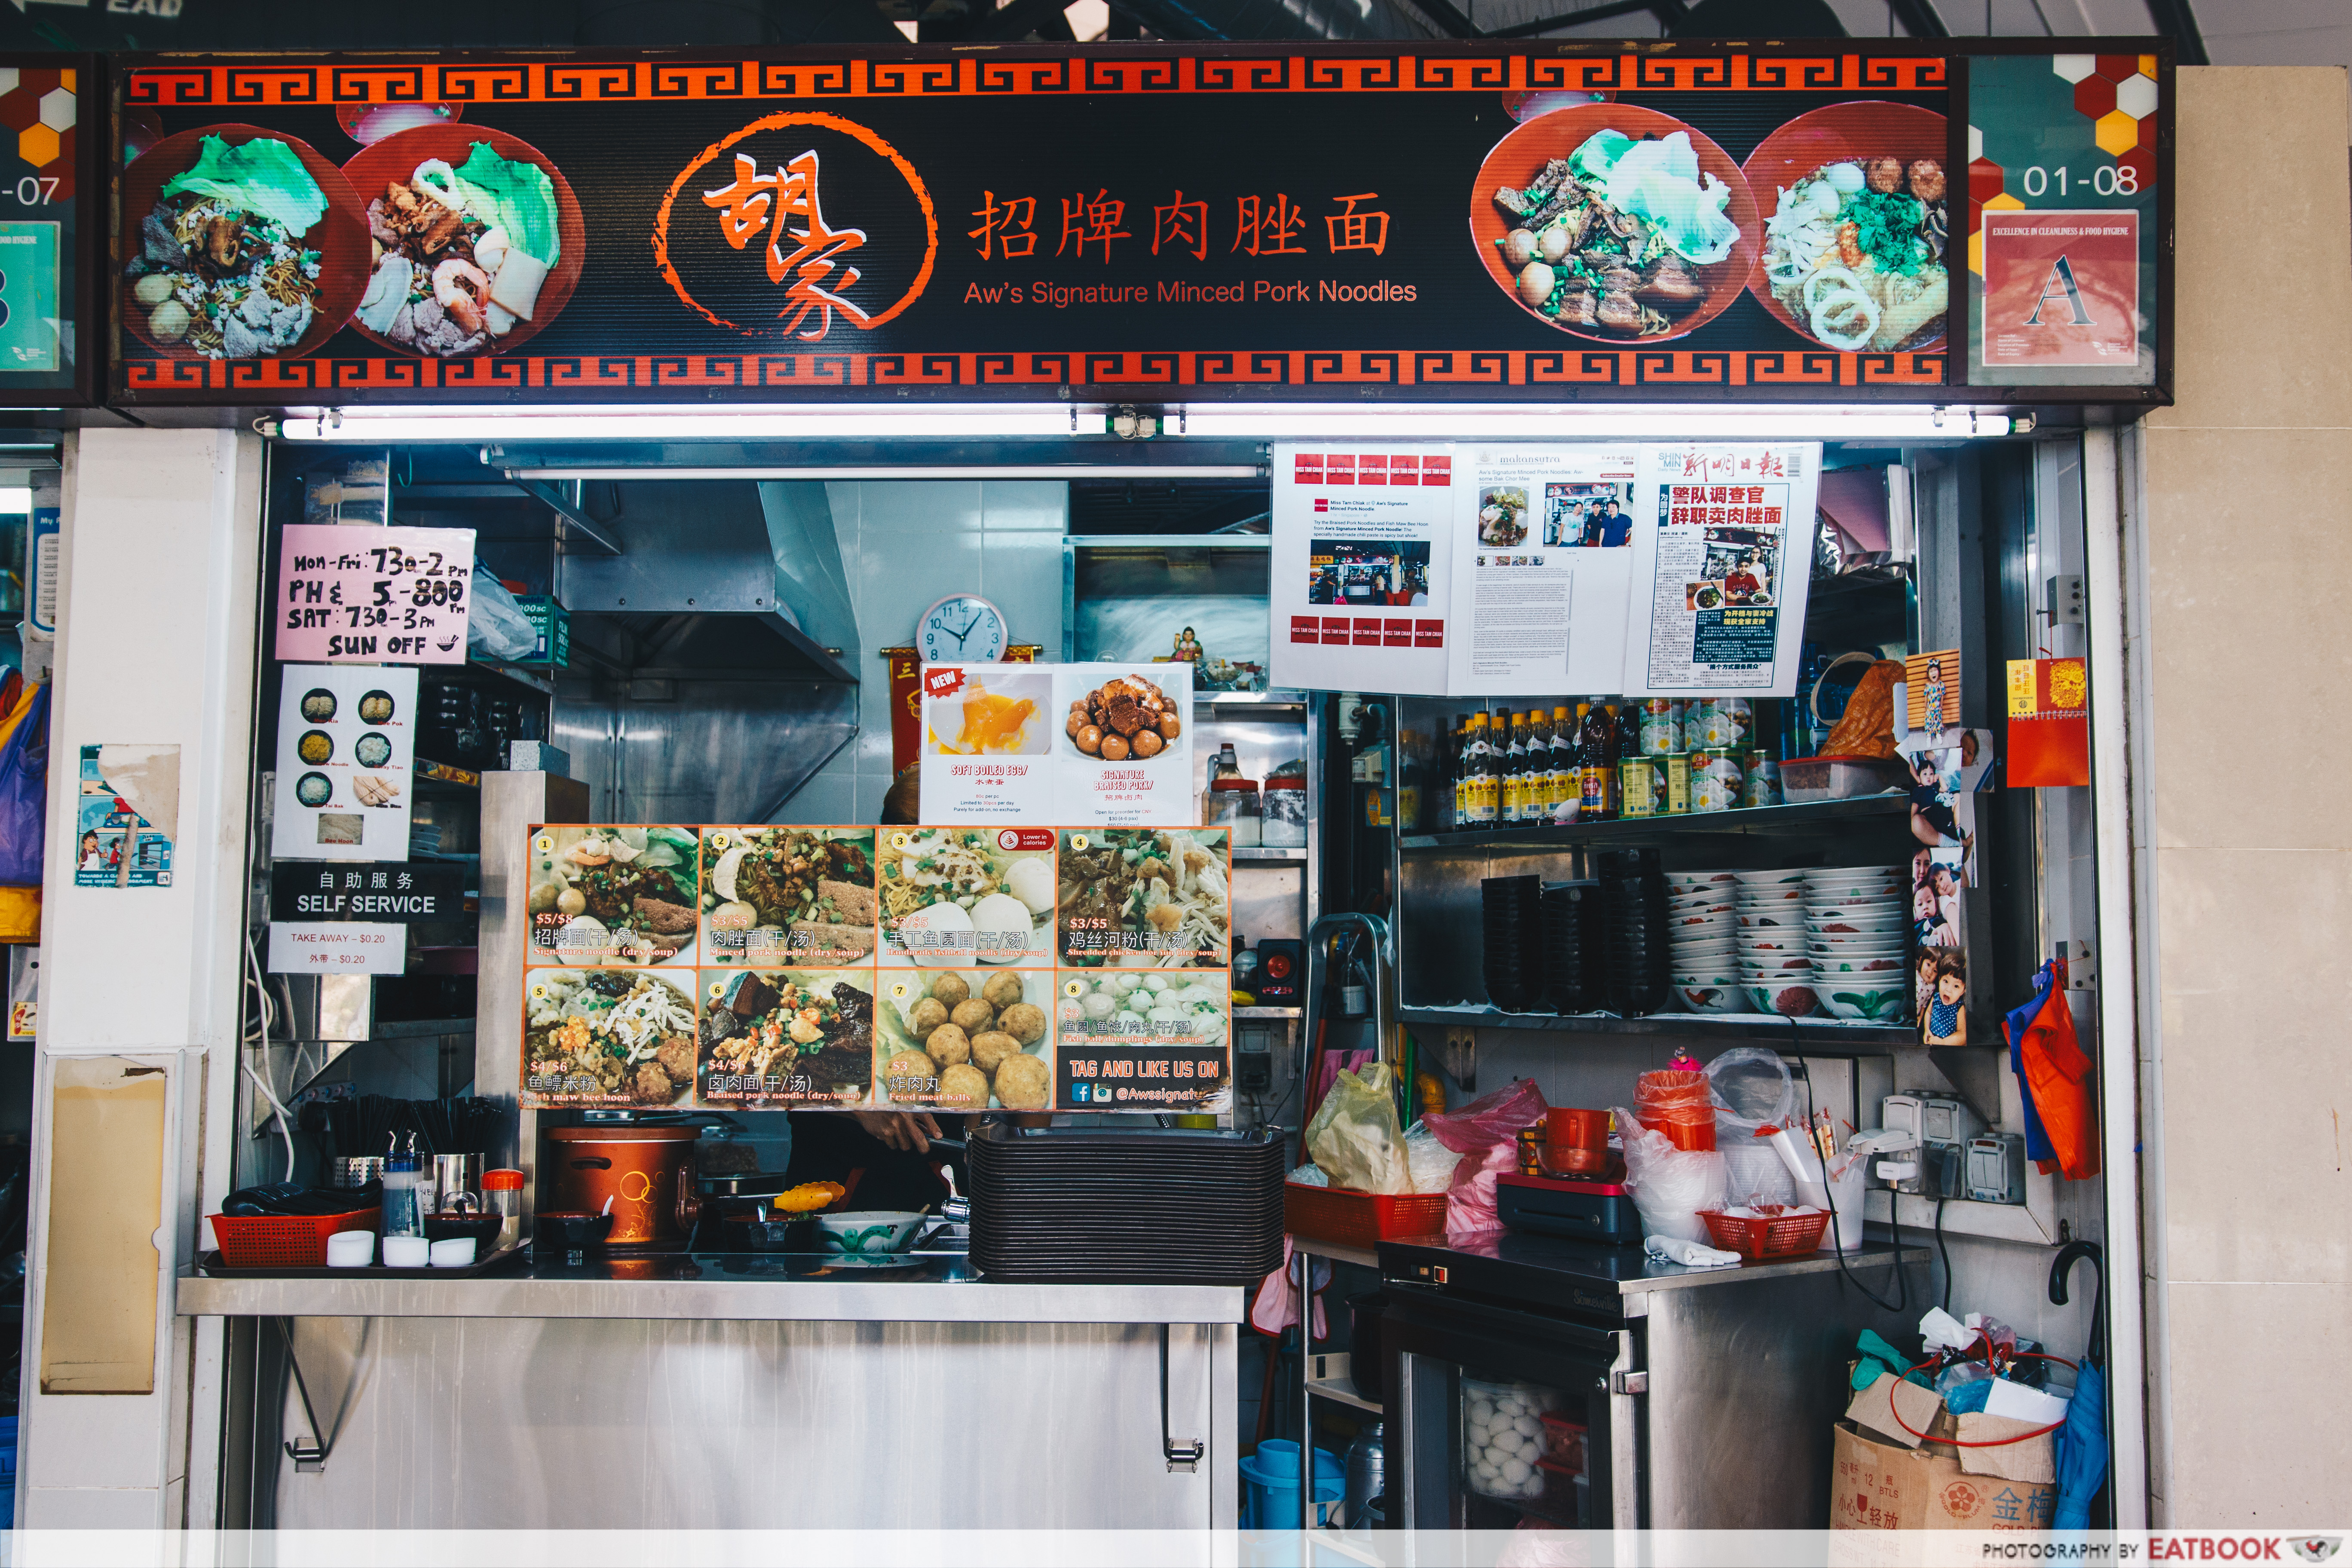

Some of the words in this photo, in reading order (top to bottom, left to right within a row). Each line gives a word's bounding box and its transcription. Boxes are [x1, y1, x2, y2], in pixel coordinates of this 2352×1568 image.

[2024, 165, 2139, 196] 01-08
[968, 188, 1390, 265] 招牌肉脞面
[1992, 227, 2030, 236] EXCELLENCE
[2030, 227, 2037, 235] IN
[2038, 227, 2078, 236] CLEANLINESS
[2079, 227, 2084, 235] &
[2103, 227, 2129, 236] HYGIENE
[964, 282, 1023, 304] Aw's
[1032, 282, 1148, 309] Signature
[1158, 281, 1244, 302] Minced
[1255, 280, 1310, 302] Pork
[1320, 279, 1417, 302] Noodles
[2023, 254, 2098, 326] A
[1500, 454, 1560, 463] makansutra
[1672, 486, 1764, 504] 警队调查官
[1660, 493, 1668, 517] 为圆梦
[1671, 506, 1782, 525] 辞职卖肉脞面
[289, 579, 323, 603] PH
[330, 581, 343, 605] &
[328, 635, 377, 657] SUN
[387, 637, 426, 655] OFF
[929, 671, 956, 689] NEW
[951, 765, 972, 775] SOFT
[974, 765, 1004, 775] BOILED
[1006, 765, 1028, 775] EGG/
[1101, 769, 1144, 780] SIGNATURE
[1094, 781, 1126, 790] BRAISED
[1128, 780, 1154, 790] PORK/
[320, 871, 413, 889] 自助服务
[297, 895, 346, 913] SELF
[352, 896, 435, 913] SERVICE
[536, 913, 573, 924] $5/$8
[711, 915, 748, 926] $3/$5
[891, 916, 928, 928] $3/$5
[1070, 917, 1107, 930] $3/$5
[291, 934, 316, 943] TAKE
[320, 934, 349, 943] AWAY
[360, 934, 385, 944] $0.20
[309, 953, 328, 964] 外带
[340, 954, 365, 964] $0.20
[533, 947, 583, 956] Signature
[585, 947, 619, 956] noodle
[623, 947, 678, 957] (dry/soup)
[710, 948, 744, 956] Minced
[747, 948, 772, 957] pork
[774, 948, 807, 956] noodle
[810, 948, 864, 958] (dry/soup)
[1065, 1008, 1080, 1019] $3
[530, 1061, 567, 1072] $4/$6
[708, 1059, 745, 1071] $4/$6
[892, 1060, 908, 1072] $3
[1070, 1060, 1097, 1078] TAG
[1102, 1060, 1133, 1078] AND
[1138, 1060, 1169, 1078] LIKE
[1173, 1061, 1194, 1078] US
[1198, 1061, 1219, 1078] ON
[889, 1075, 941, 1092] 炸肉丸
[888, 1093, 916, 1101] Fried
[946, 1093, 971, 1101] balls
[1865, 1473, 1873, 1487] 12
[1879, 1486, 1899, 1499] BTLS
[1992, 1487, 2052, 1522] 金梅
[1869, 1506, 1899, 1531] 轻放
